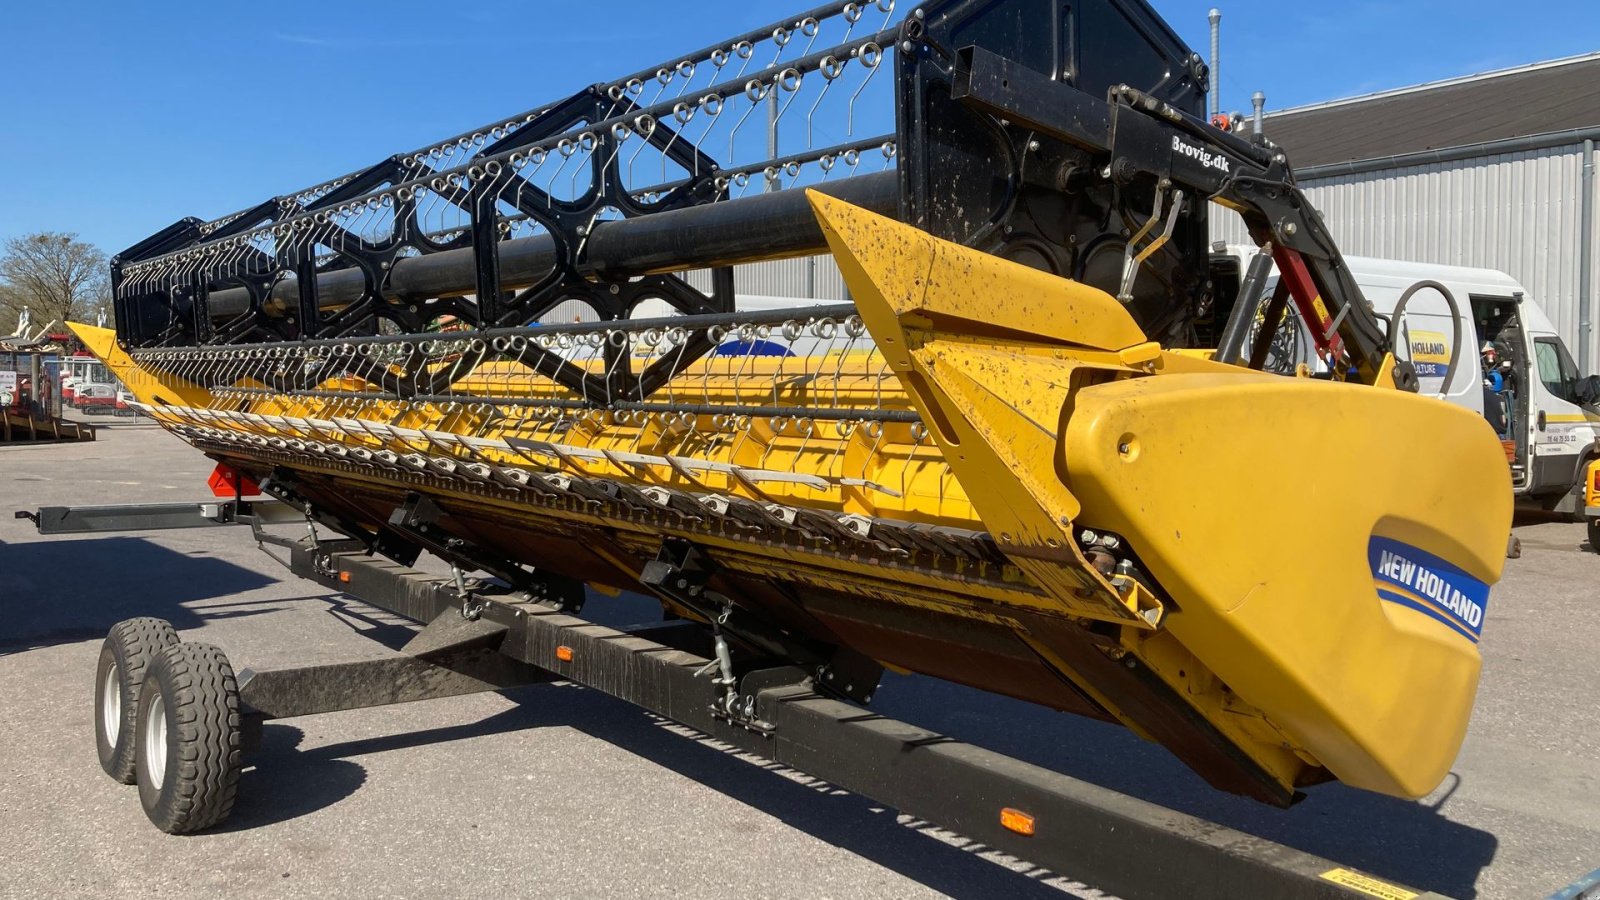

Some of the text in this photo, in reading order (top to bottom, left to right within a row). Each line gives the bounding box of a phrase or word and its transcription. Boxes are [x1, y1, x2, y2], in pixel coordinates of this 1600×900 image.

[1172, 135, 1229, 172] Brovig.dk
[1411, 342, 1445, 355] HOLLAND
[1415, 364, 1436, 374] ULTURE
[1378, 549, 1482, 628] NEW HOLLAND
